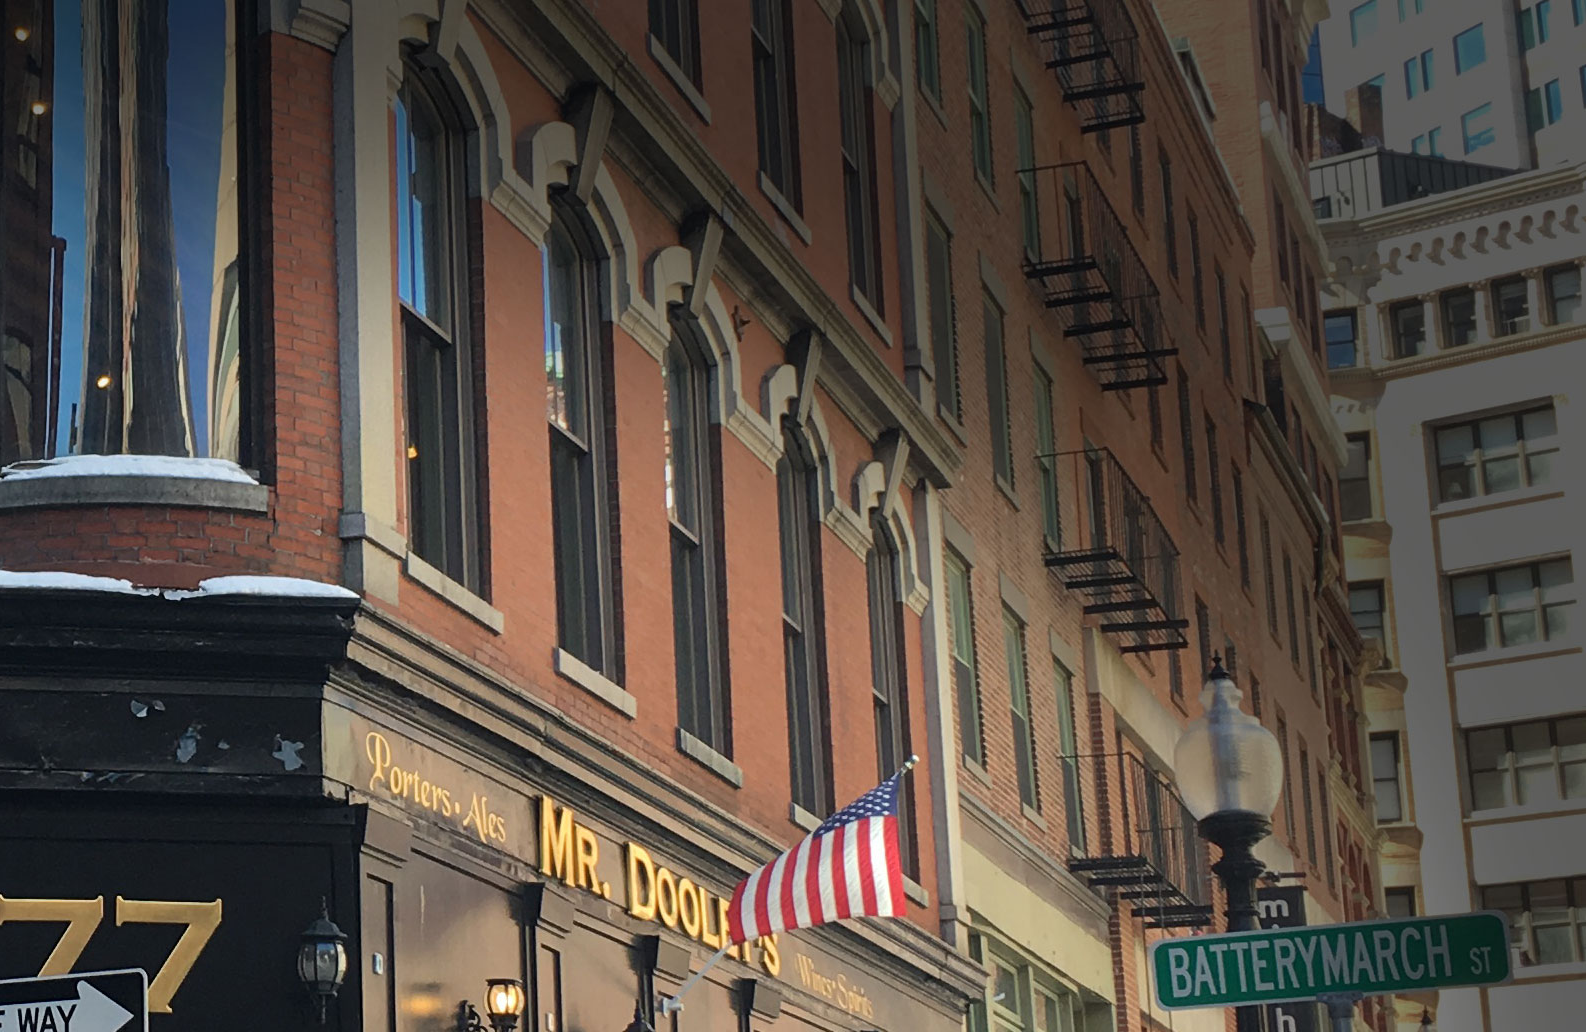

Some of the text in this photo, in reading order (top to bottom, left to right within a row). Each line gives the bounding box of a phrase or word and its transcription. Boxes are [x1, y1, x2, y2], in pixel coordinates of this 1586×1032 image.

[366, 731, 506, 844] Porters Ales
[541, 795, 781, 976] MR. DOOLE'S
[1168, 924, 1492, 998] BATTERYMARCH ST
